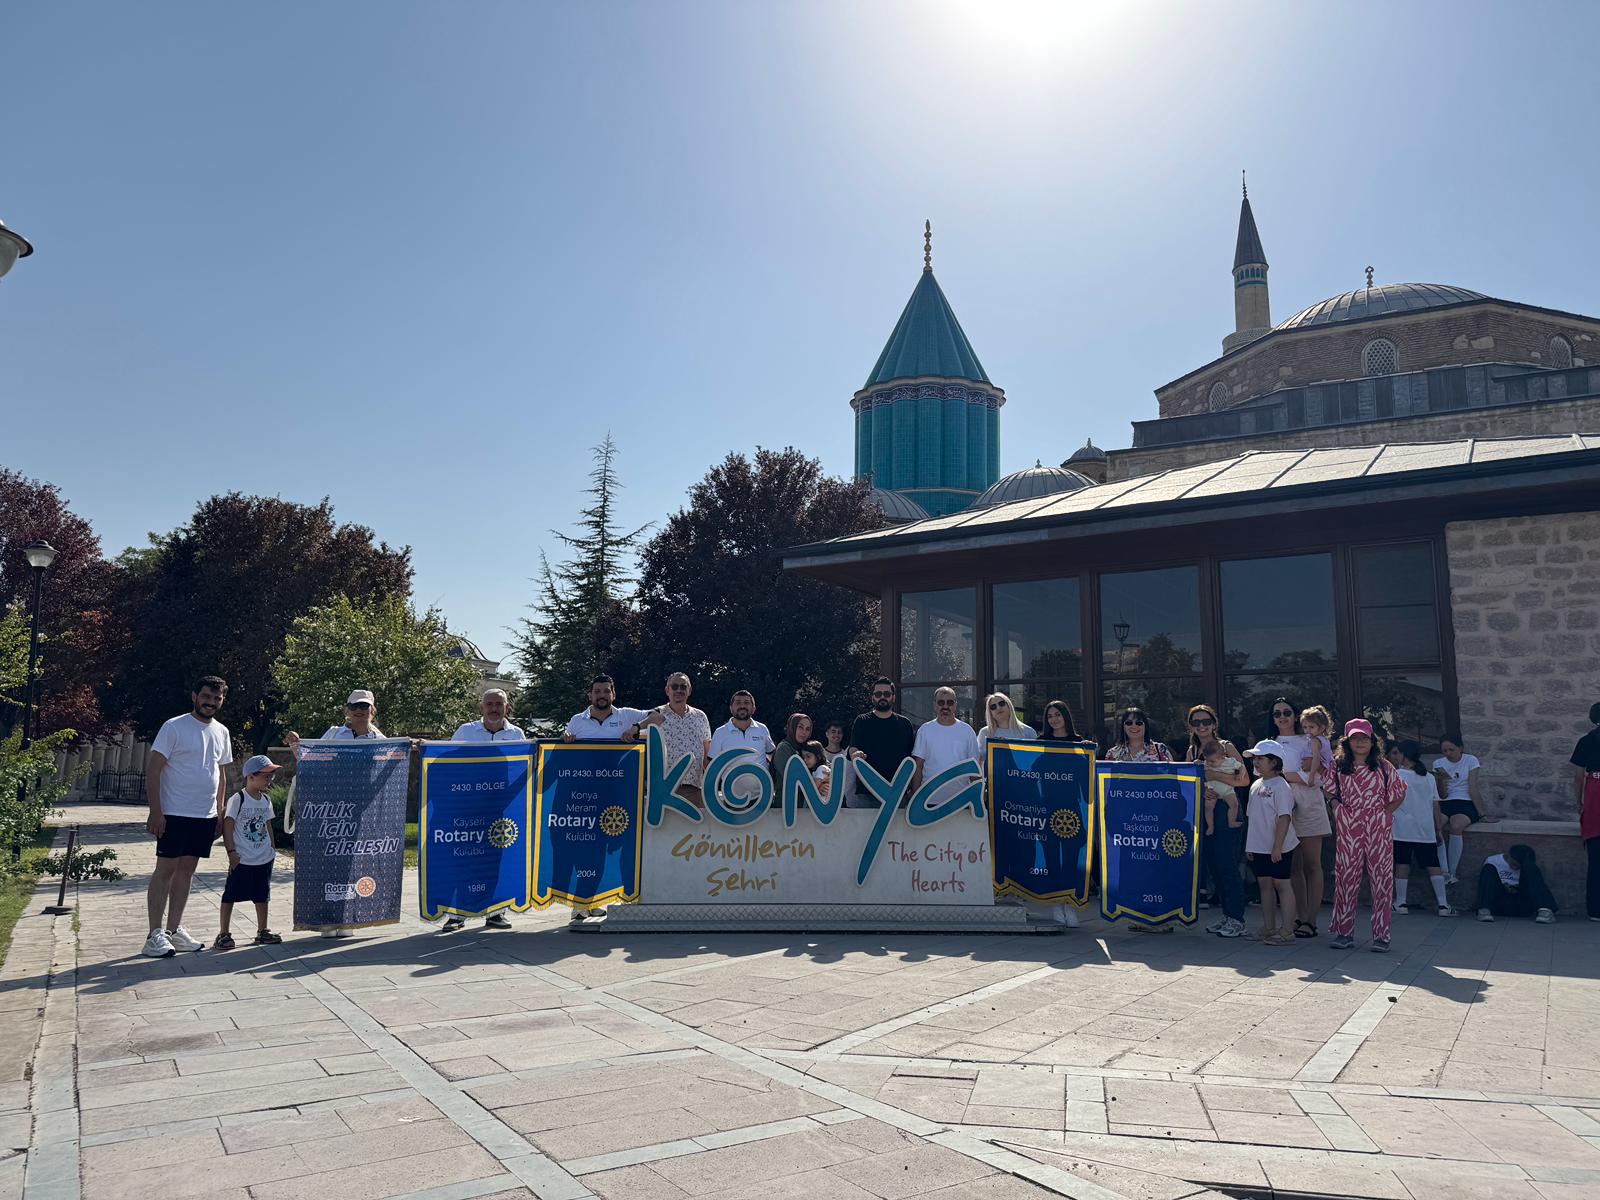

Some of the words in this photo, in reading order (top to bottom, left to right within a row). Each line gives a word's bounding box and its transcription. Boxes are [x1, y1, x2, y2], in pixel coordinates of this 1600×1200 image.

[558, 769, 571, 777] UR
[595, 768, 625, 778] BÖLGE
[1007, 769, 1020, 777] UR
[1044, 771, 1073, 781] BÖLGE
[571, 791, 598, 801] Konya
[1109, 790, 1123, 798] UR
[1146, 790, 1178, 800] BÖLGE
[566, 803, 598, 812] Meram
[1004, 800, 1047, 814] Osmaniye
[453, 817, 485, 828] Kayseri
[548, 814, 596, 830] Rotary
[1000, 810, 1046, 829] Rotary
[1131, 812, 1159, 822] Adana
[318, 819, 356, 839] İÇİN
[434, 828, 484, 843] Rotary
[1113, 833, 1159, 850] Rotary
[324, 836, 399, 857] BİRLEŞİN
[888, 841, 919, 862] The
[924, 841, 963, 873] City
[967, 842, 987, 864] of
[576, 869, 596, 878] 2004
[1029, 867, 1049, 876] 2019
[706, 866, 778, 897] Şehri
[911, 869, 966, 893] Hearts
[325, 883, 356, 894] Rotary
[1143, 894, 1163, 903] 2019
